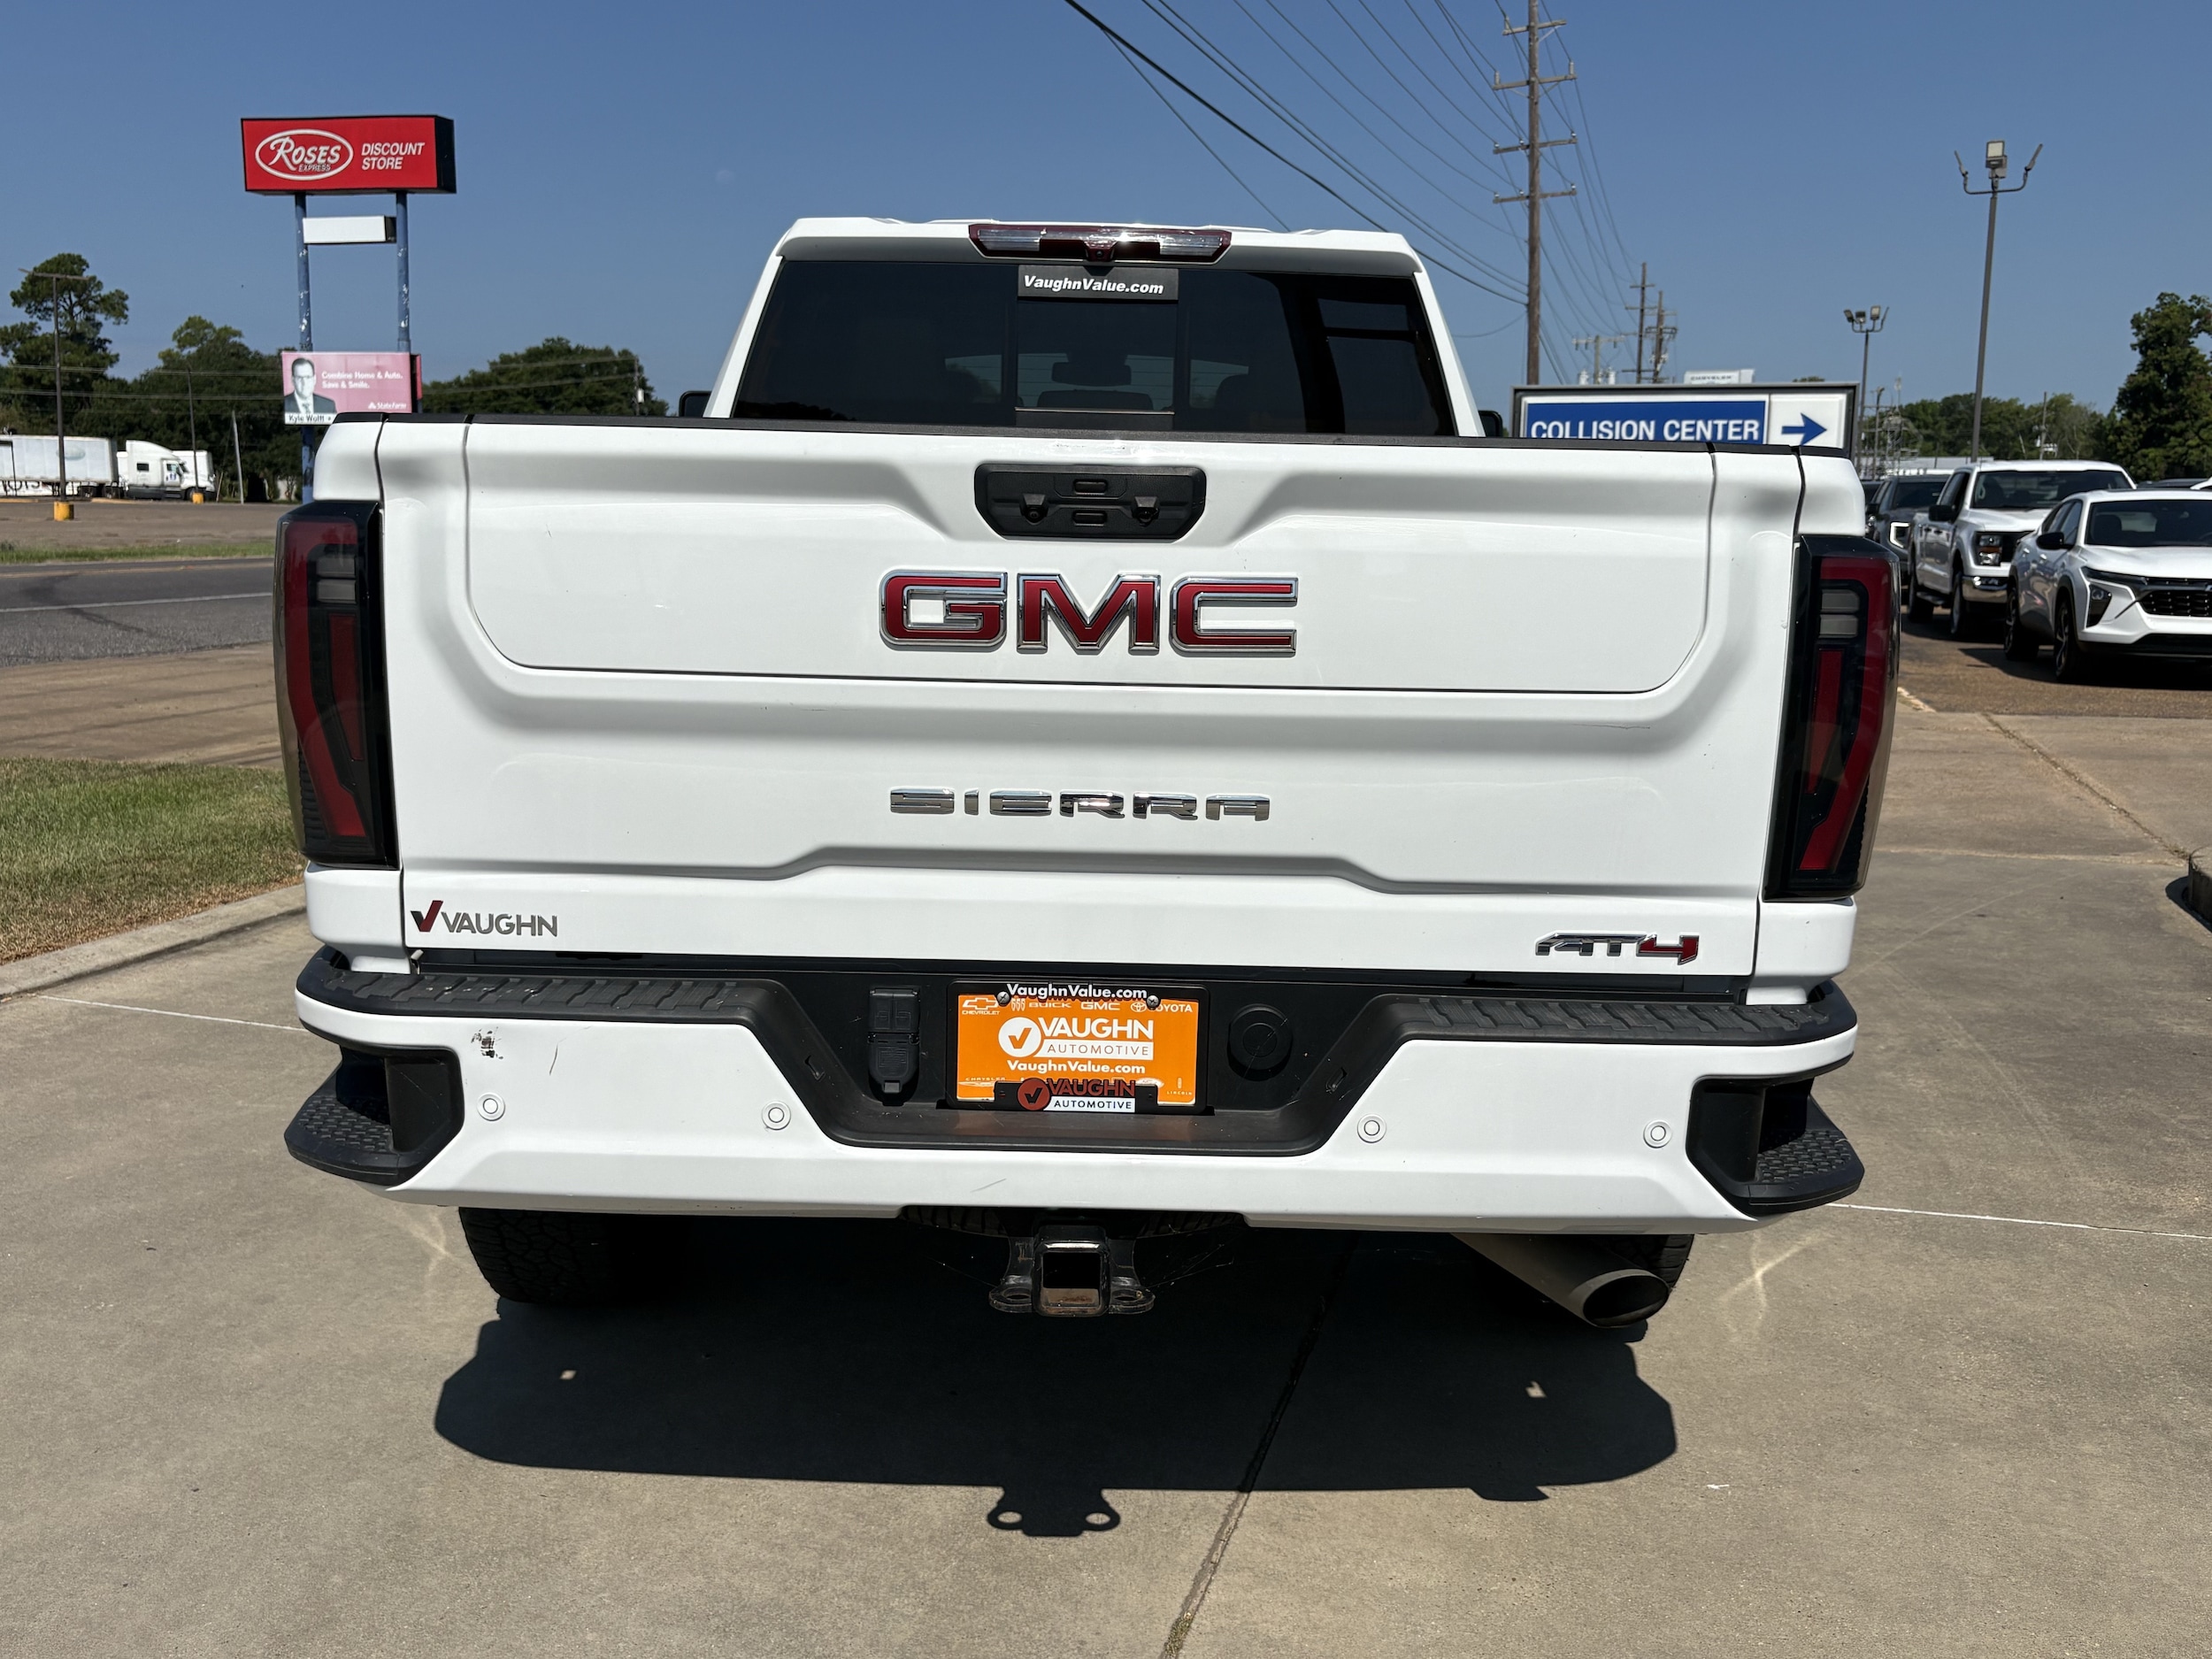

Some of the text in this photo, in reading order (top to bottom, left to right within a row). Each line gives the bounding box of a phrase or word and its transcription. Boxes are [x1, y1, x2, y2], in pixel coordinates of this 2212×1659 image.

[361, 142, 425, 156] DISCOUNT
[362, 157, 403, 170] STORE
[1024, 275, 1164, 295] VaughnValue.com
[321, 371, 353, 380] Combine
[354, 371, 375, 380] Home
[288, 415, 304, 424] Kyle
[1531, 419, 1760, 441] COLLISION CENTER
[879, 570, 1299, 657] GMC
[889, 787, 1271, 821] SIERRA
[441, 911, 558, 938] VAUGHN
[1535, 932, 1700, 965] AT4
[1007, 984, 1148, 1000] VaughnValue.com
[1080, 1002, 1121, 1011] GMC
[1154, 1003, 1193, 1013] OYOTA
[1038, 1018, 1155, 1039] VAUGHN
[1047, 1044, 1149, 1056] AUTOMOTIVE
[1007, 1060, 1146, 1074] VaughnValue.com
[1048, 1079, 1136, 1097] VAUGHN
[1054, 1100, 1133, 1110] AUTOMOTIVE
